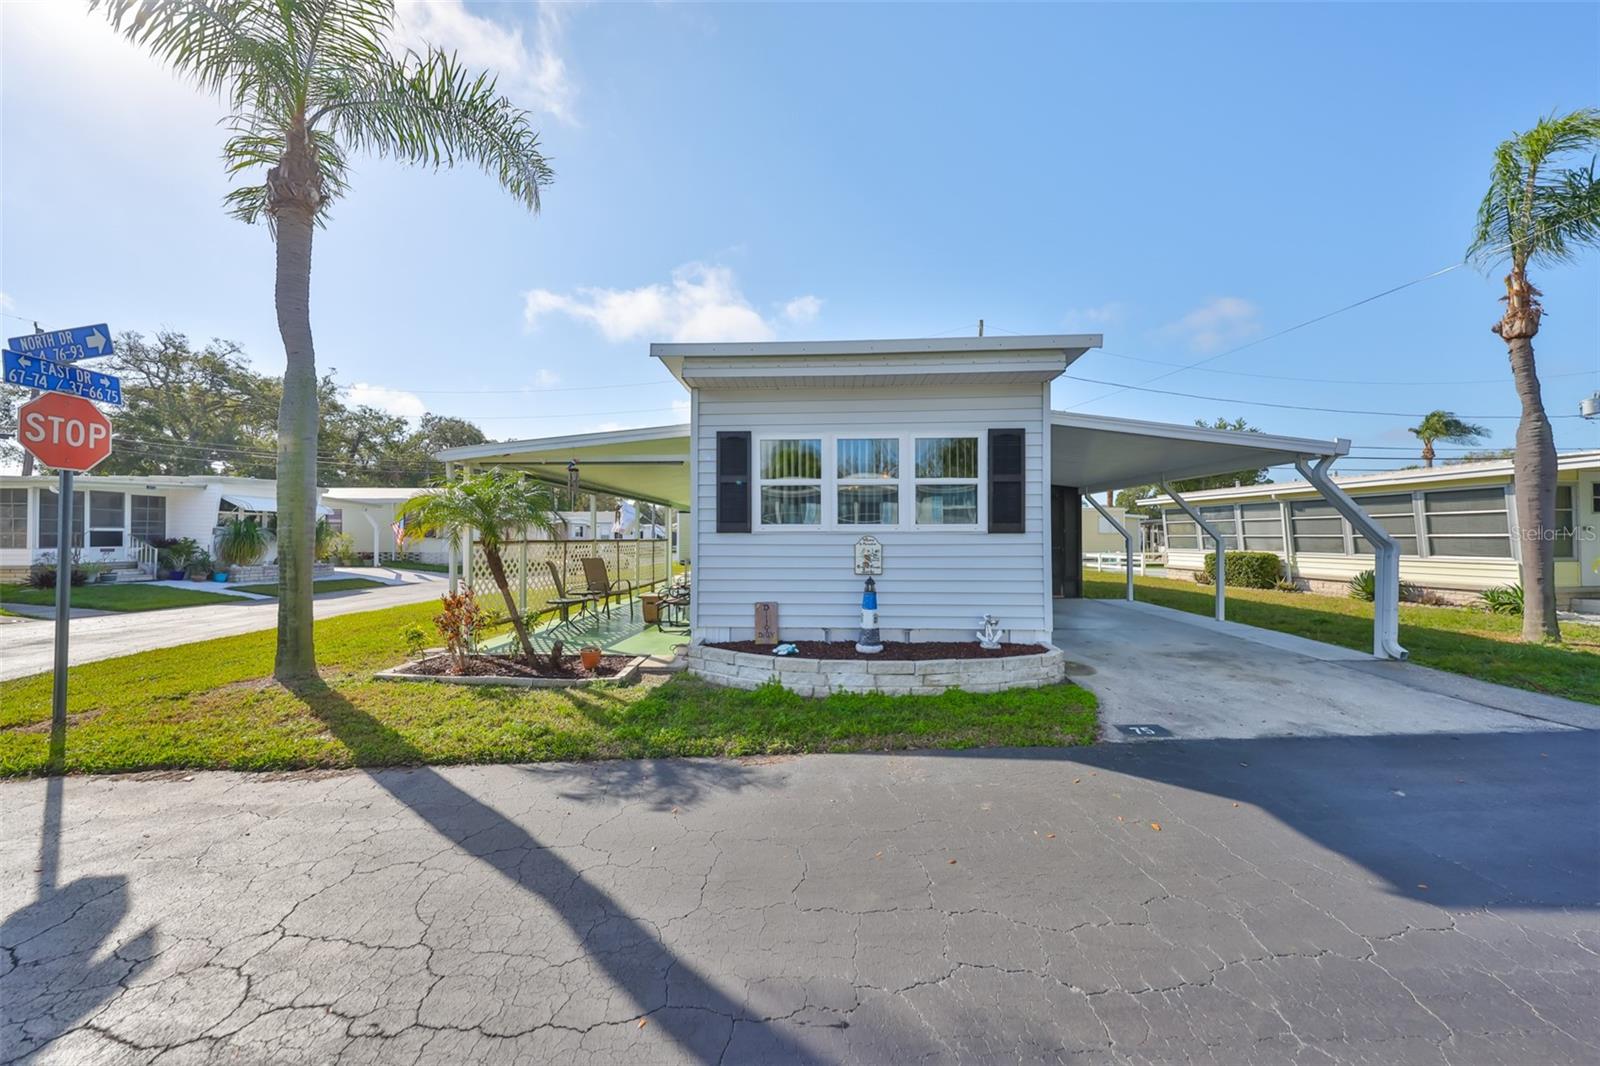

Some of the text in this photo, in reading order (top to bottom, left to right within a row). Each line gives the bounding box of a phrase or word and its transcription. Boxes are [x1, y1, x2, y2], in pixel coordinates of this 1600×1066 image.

[20, 331, 74, 351] NORTH DR
[53, 345, 85, 361] 76-93
[9, 369, 48, 388] 67-74
[40, 360, 92, 385] EAST DR
[25, 412, 107, 449] STOP
[1128, 726, 1156, 735] 75
